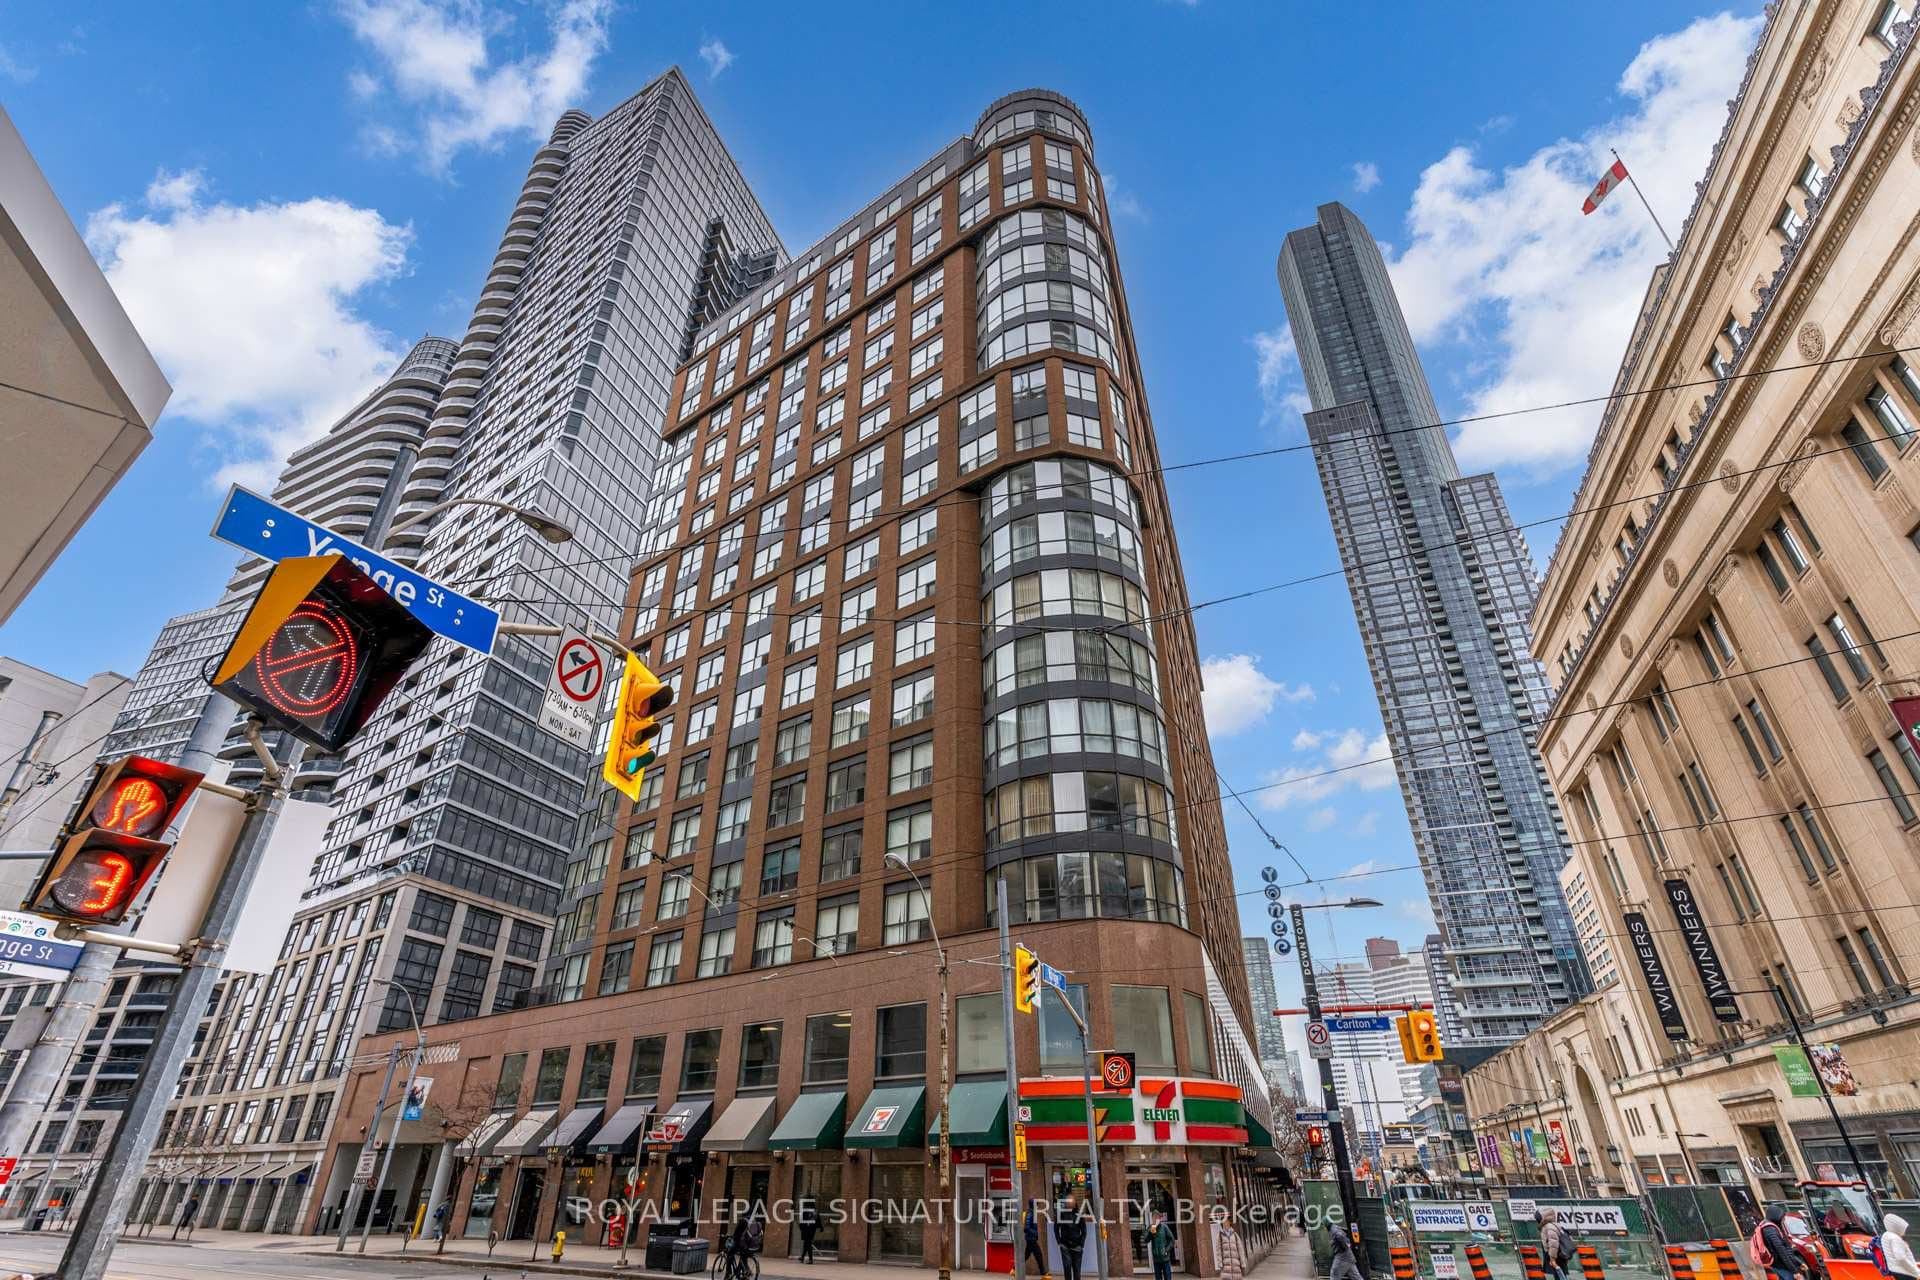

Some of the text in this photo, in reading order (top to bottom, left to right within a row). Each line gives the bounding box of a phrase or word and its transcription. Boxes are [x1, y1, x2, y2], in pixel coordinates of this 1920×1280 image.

[426, 587, 446, 608] St
[1294, 909, 1313, 977] DOWNTOWN
[1673, 889, 1723, 989] WINNERS
[35, 945, 54, 960] St
[1631, 920, 1673, 1012] WINNERS
[1335, 1019, 1371, 1029] Carlton
[970, 1151, 1005, 1160] Scotiabank
[1414, 1208, 1464, 1216] CONSTRUCTION
[1468, 1205, 1493, 1215] GATE
[1415, 1215, 1466, 1225] ENTRANCE
